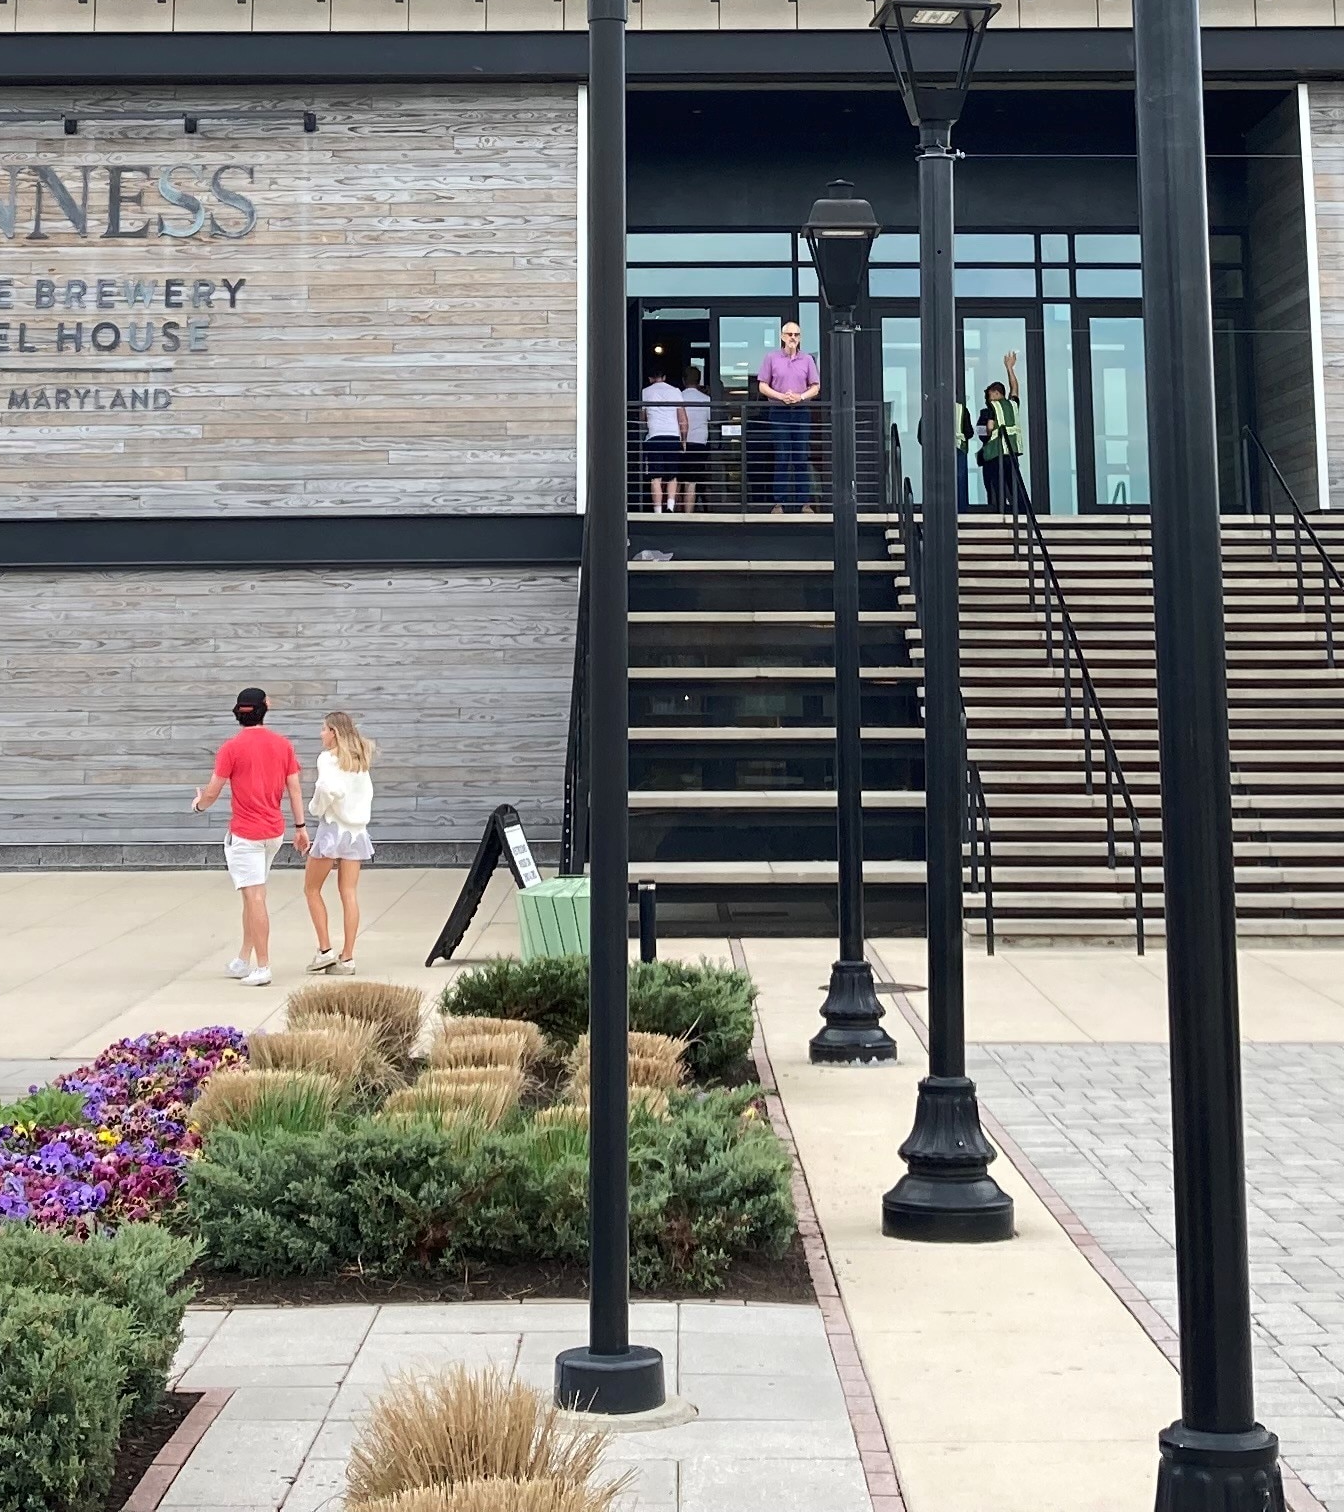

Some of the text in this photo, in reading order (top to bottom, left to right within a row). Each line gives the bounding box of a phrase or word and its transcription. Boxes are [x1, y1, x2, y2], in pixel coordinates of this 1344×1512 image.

[35, 278, 246, 309] BREWERY
[57, 320, 209, 353] HOUSE
[8, 388, 172, 411] MARYLAND
